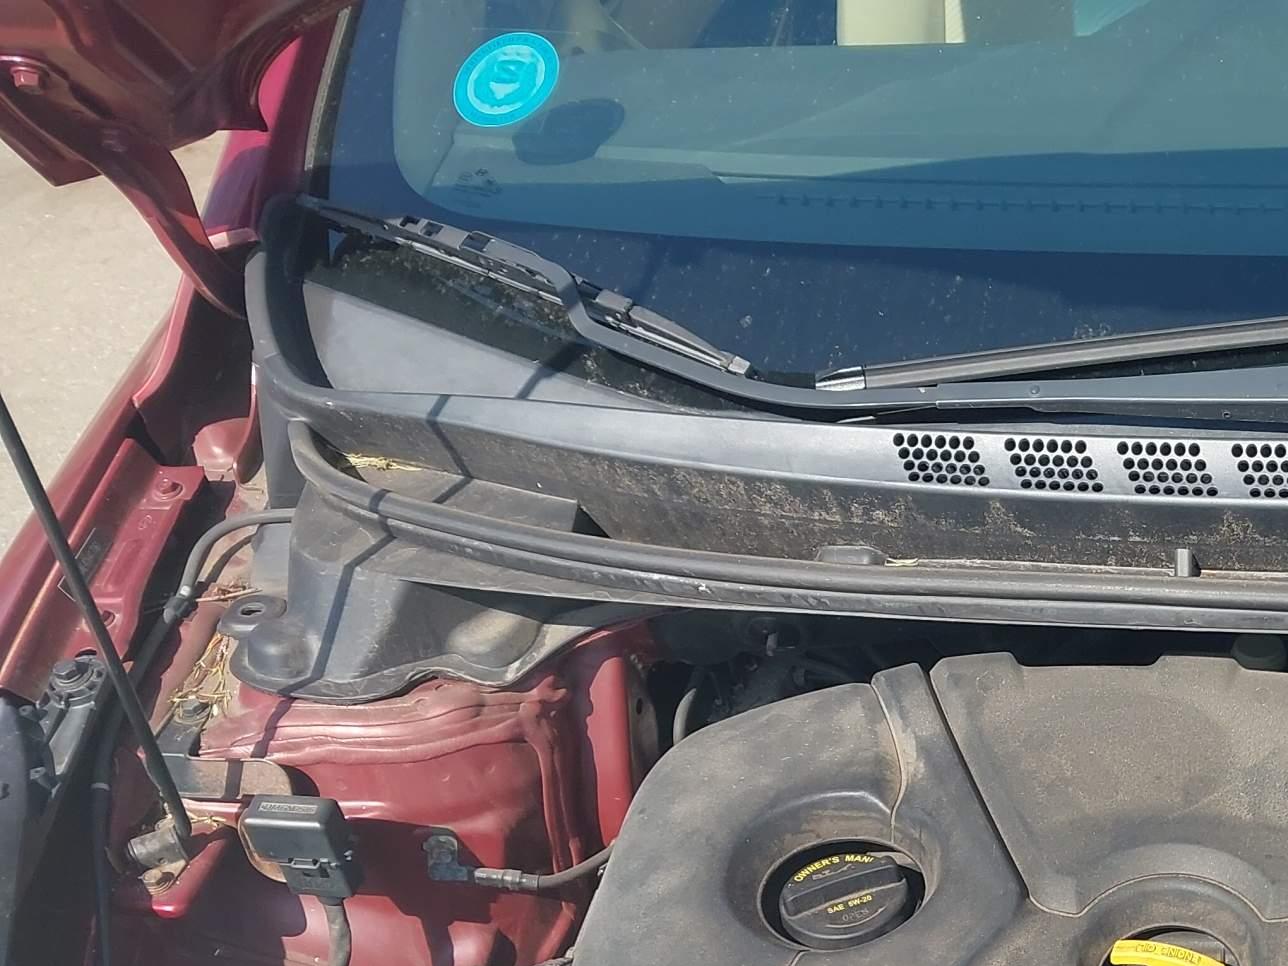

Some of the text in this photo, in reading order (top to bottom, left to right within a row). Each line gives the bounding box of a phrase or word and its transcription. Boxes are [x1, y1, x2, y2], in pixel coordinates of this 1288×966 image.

[793, 855, 841, 882] OWNER'S
[827, 894, 873, 914] SAE 5W-20
